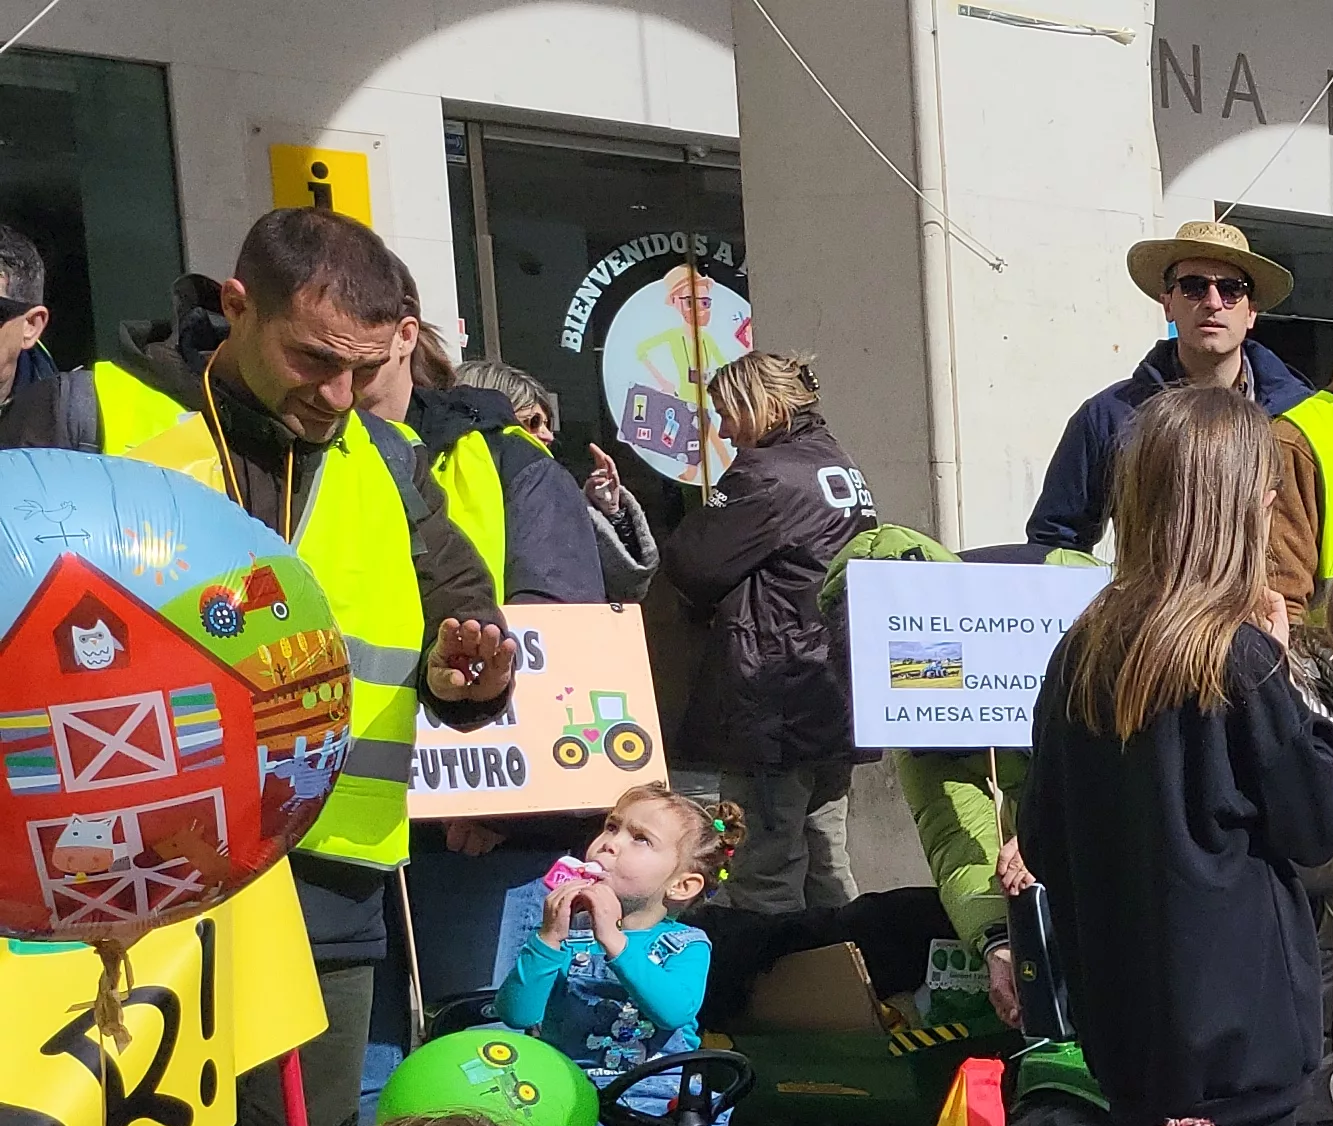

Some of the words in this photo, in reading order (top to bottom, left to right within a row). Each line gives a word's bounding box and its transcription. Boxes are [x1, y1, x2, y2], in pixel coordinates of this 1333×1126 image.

[1158, 38, 1267, 126] NA
[560, 231, 708, 352] BIENVENIDOS
[712, 240, 734, 267] A
[888, 616, 924, 632] SIN
[930, 616, 954, 632] EL
[959, 617, 1035, 633] CAMPO
[1040, 618, 1053, 634] Y
[885, 706, 911, 722] LA
[916, 706, 974, 722] MESA
[979, 706, 1028, 722] ESTA
